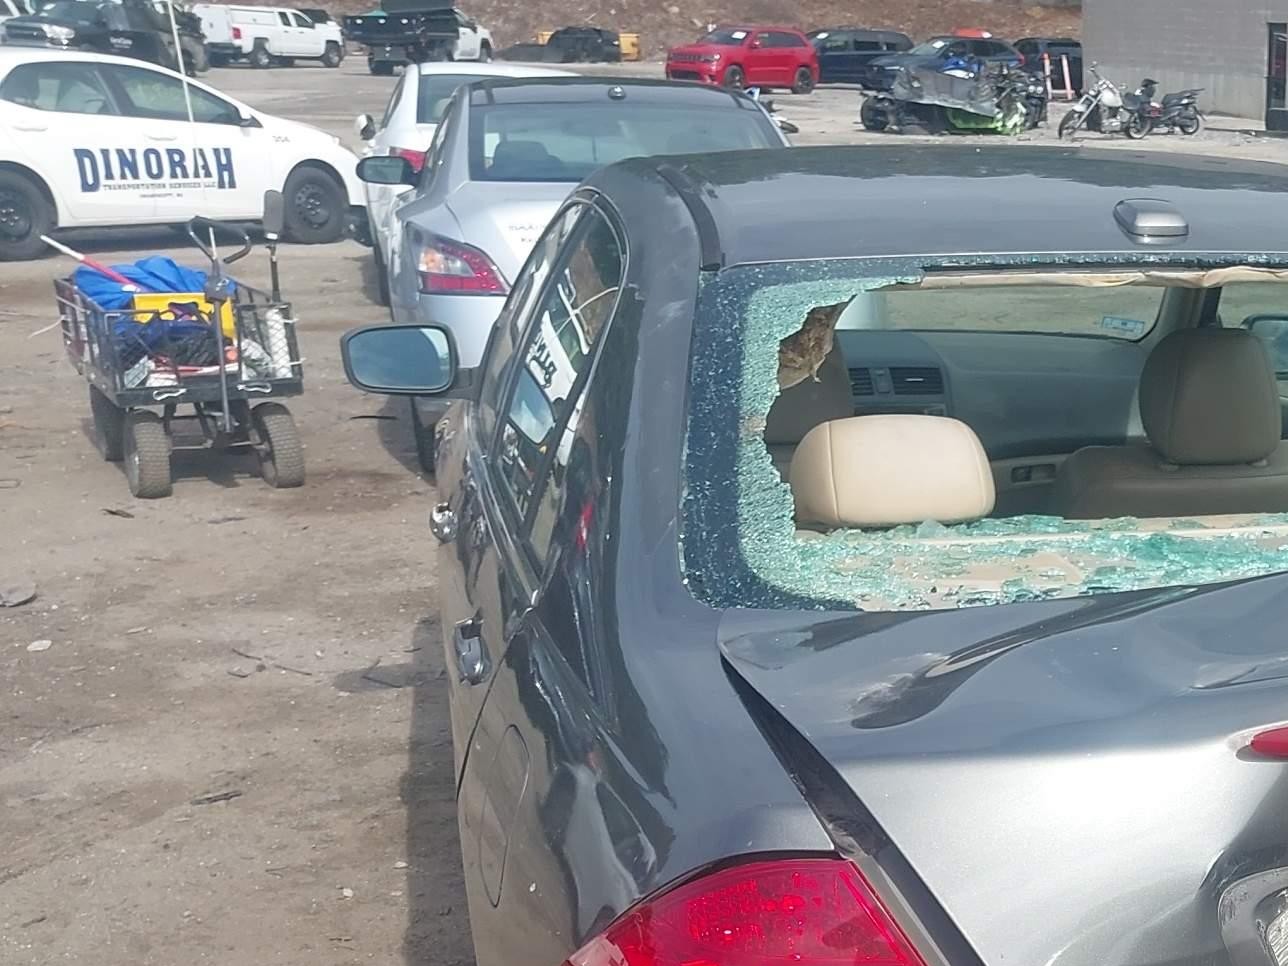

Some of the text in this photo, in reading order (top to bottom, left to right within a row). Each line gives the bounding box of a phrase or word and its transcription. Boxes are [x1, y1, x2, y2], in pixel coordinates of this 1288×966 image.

[73, 148, 237, 193] DINORAH
[102, 182, 167, 191] TRANSPORTATION
[169, 181, 201, 190] SERVICES
